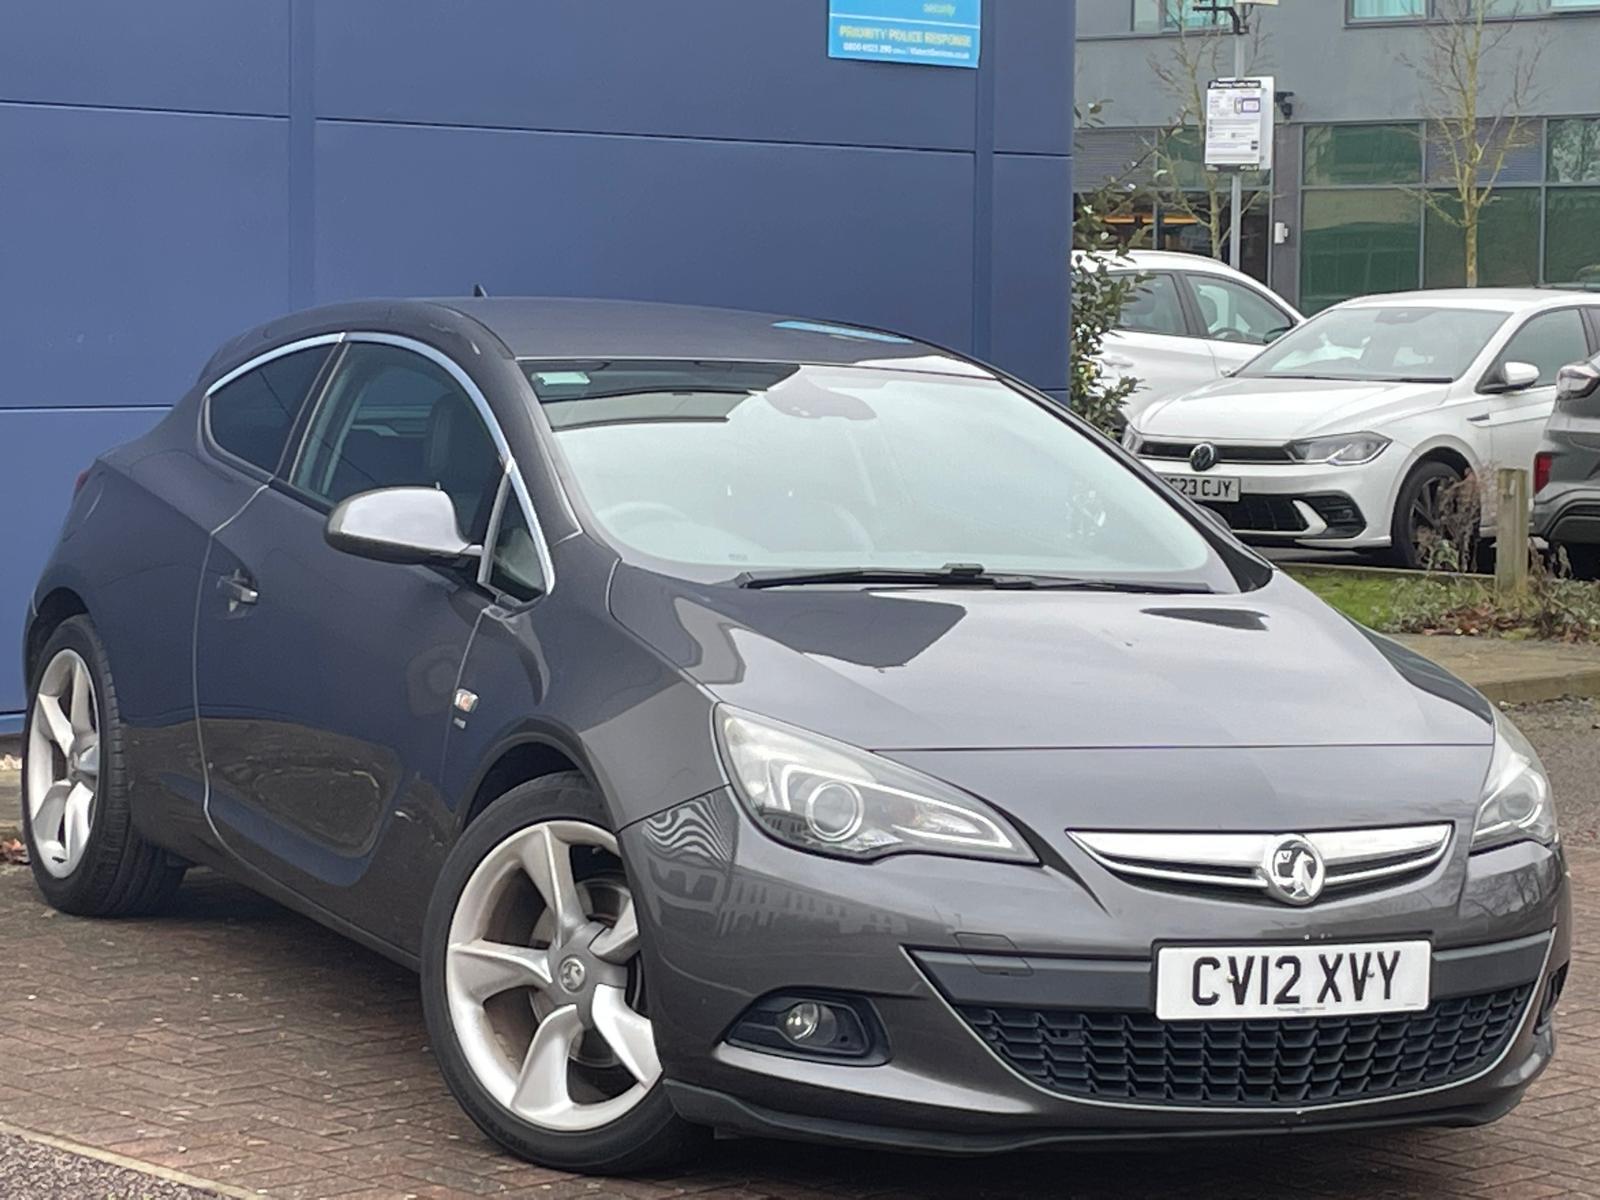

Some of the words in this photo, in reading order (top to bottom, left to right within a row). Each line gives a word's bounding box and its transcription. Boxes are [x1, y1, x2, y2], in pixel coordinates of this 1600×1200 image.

[839, 25, 886, 40] PRIORITY
[889, 28, 924, 43] POLICE
[924, 31, 971, 47] RESPONSE
[1201, 480, 1232, 497] CJY
[1192, 955, 1301, 1006] CV12
[1316, 950, 1401, 1004] XVY
